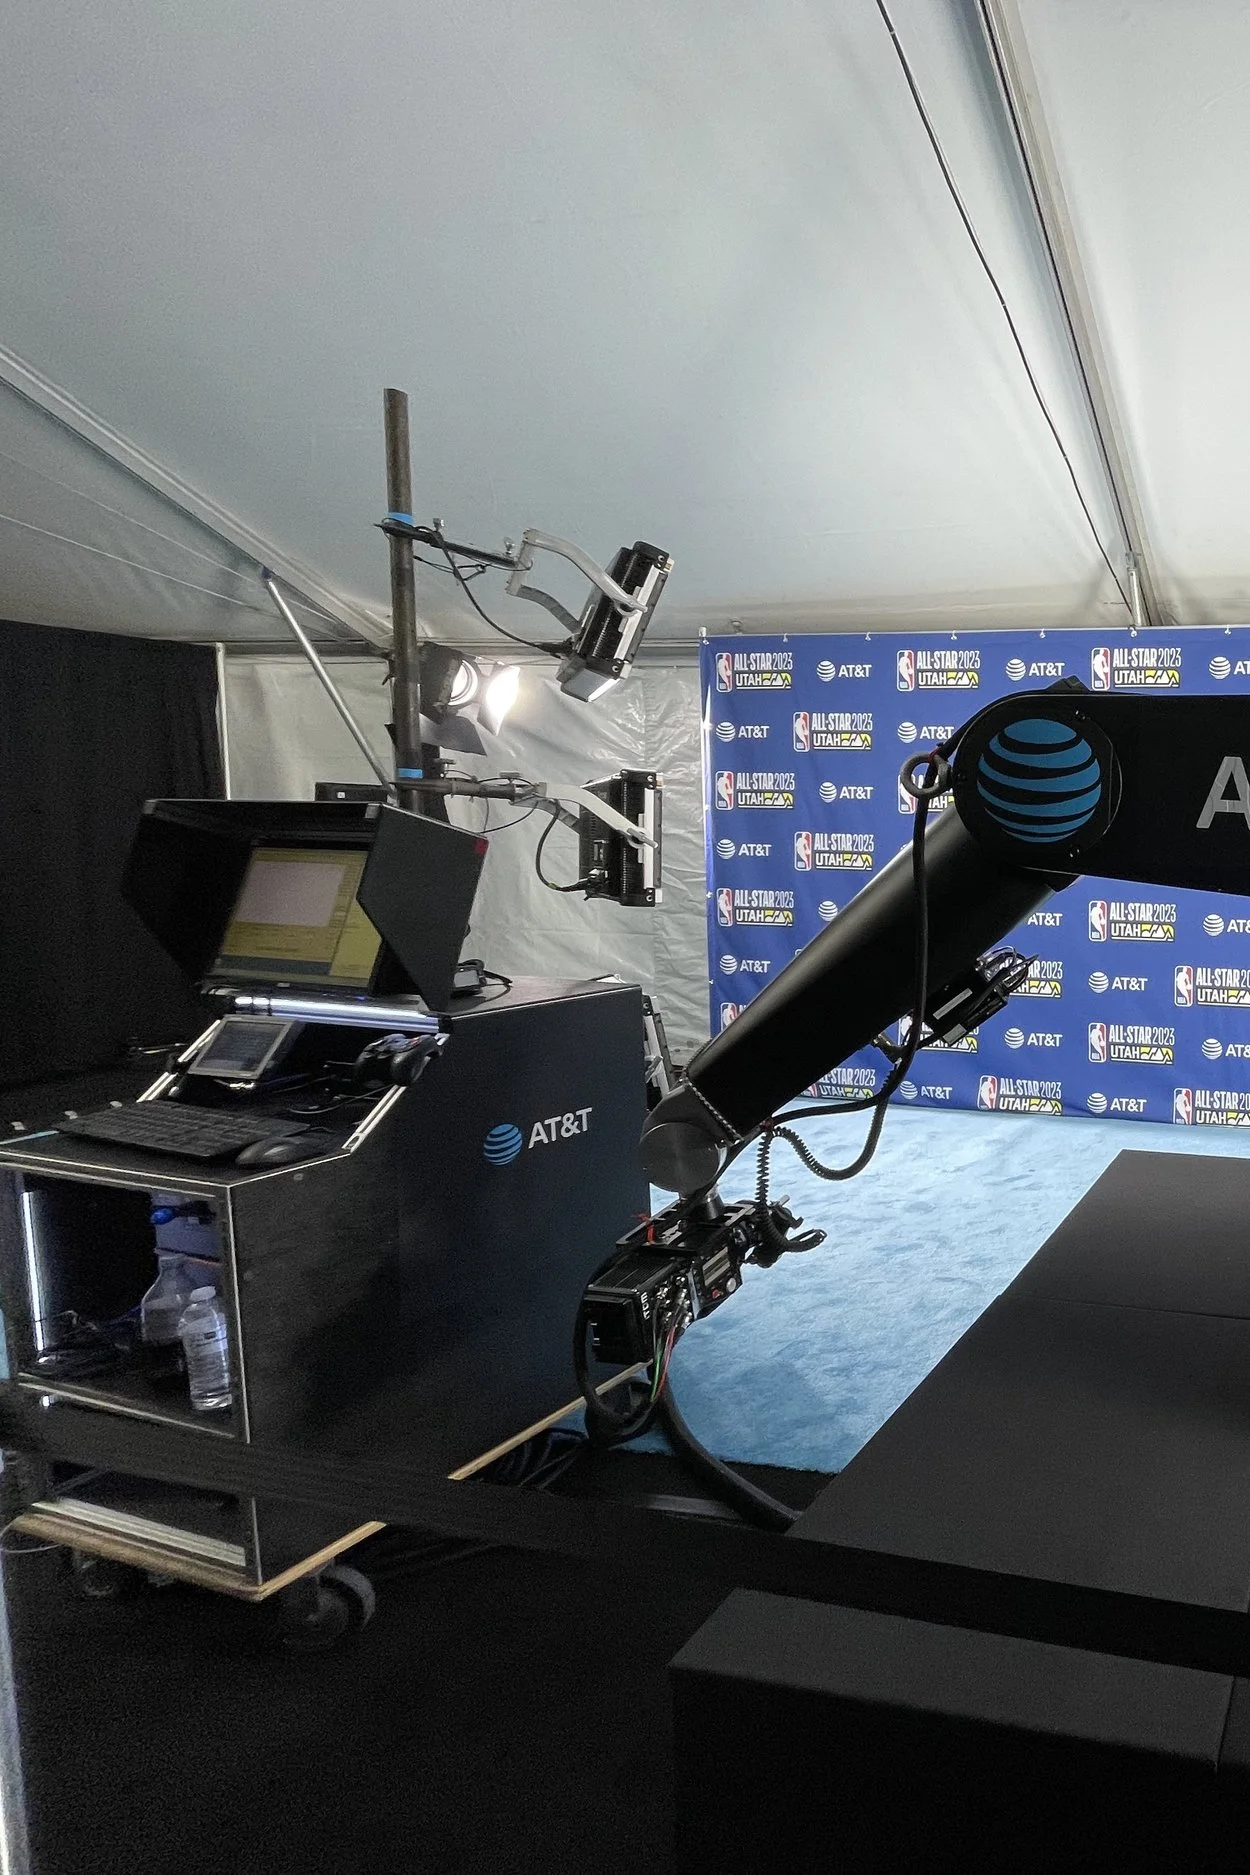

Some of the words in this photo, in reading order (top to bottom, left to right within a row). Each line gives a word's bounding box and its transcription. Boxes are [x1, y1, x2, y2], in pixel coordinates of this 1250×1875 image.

[772, 652, 793, 670] 2023
[955, 650, 981, 669] 2023
[1158, 648, 1182, 667] 2023
[838, 665, 872, 678] AT&T
[1029, 663, 1065, 676] AT&T
[736, 673, 761, 686] UTAH
[918, 672, 946, 685] UTAH
[1114, 670, 1145, 683] UTAH
[852, 713, 873, 731] 2023
[738, 726, 770, 739] AT&T
[920, 727, 954, 739] AT&T
[813, 734, 841, 746] UTAH
[775, 772, 795, 790] 2023
[737, 793, 765, 805] UTAH
[839, 787, 873, 800] AT&T
[853, 833, 875, 852] 2023
[738, 844, 772, 857] AT&T
[815, 853, 844, 866] UTAH
[775, 891, 794, 909] 2023
[736, 910, 765, 922] UTAH
[1027, 913, 1063, 926] AT&T
[1153, 904, 1177, 923] 2023
[1111, 924, 1141, 937] UTAH
[740, 960, 771, 973] AT&T
[1041, 961, 1063, 979] 2023
[1111, 977, 1148, 991] AT&T
[1197, 989, 1228, 1002] UTAH
[1027, 1034, 1063, 1047] AT&T
[1152, 1027, 1175, 1046] 2023
[1110, 1046, 1140, 1059] UTAH
[854, 1069, 876, 1087] 2023
[819, 1085, 845, 1096] UTAH
[920, 1086, 952, 1100] AT&T
[1039, 1080, 1062, 1099] 2023
[999, 1098, 1029, 1111] UTAH
[1110, 1098, 1147, 1112] AT&T
[1196, 1111, 1227, 1124] UTAH
[528, 1107, 593, 1149] AT&T
